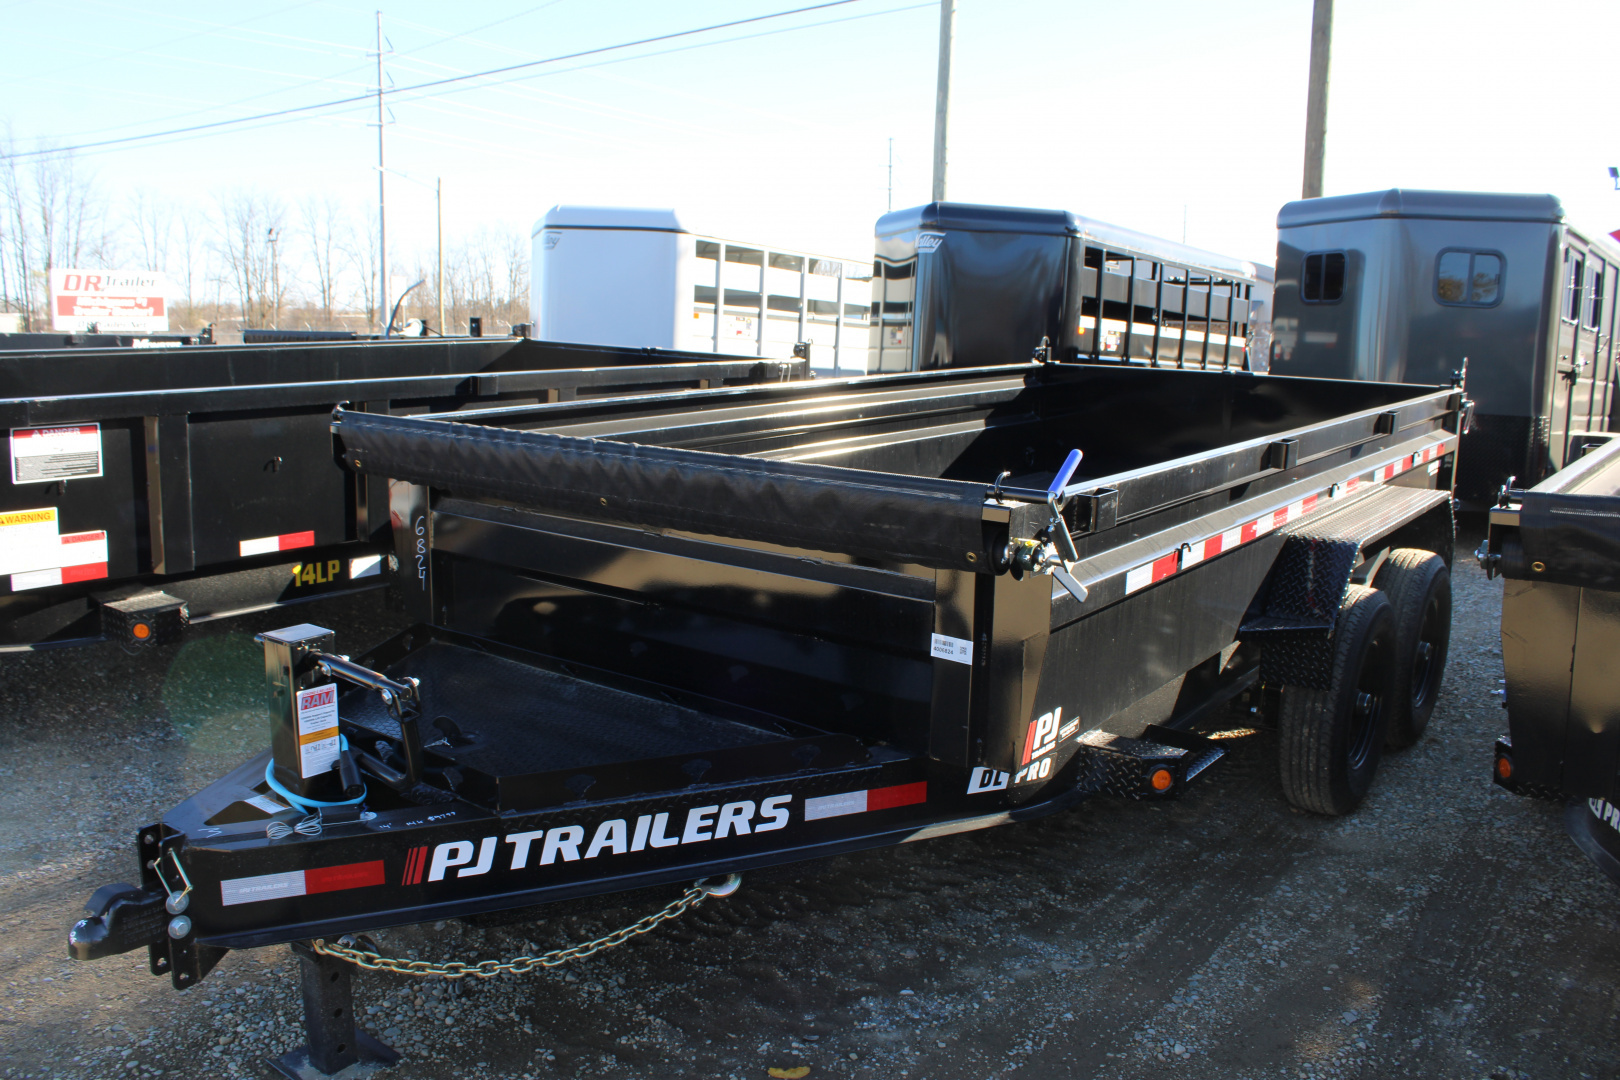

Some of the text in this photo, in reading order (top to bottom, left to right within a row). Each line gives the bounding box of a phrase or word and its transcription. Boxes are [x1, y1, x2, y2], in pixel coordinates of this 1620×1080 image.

[63, 274, 156, 291] DR Trailer
[42, 427, 80, 437] DANGER
[5, 511, 51, 525] WARNING
[71, 533, 100, 543] DANGER
[415, 515, 426, 591] 6824
[292, 559, 340, 587] 14LP
[301, 690, 335, 710] RAM
[1033, 706, 1062, 750] PJ
[1014, 757, 1052, 784] PRO
[1603, 801, 1620, 834] PR
[427, 794, 793, 883] PJ TRAILERS
